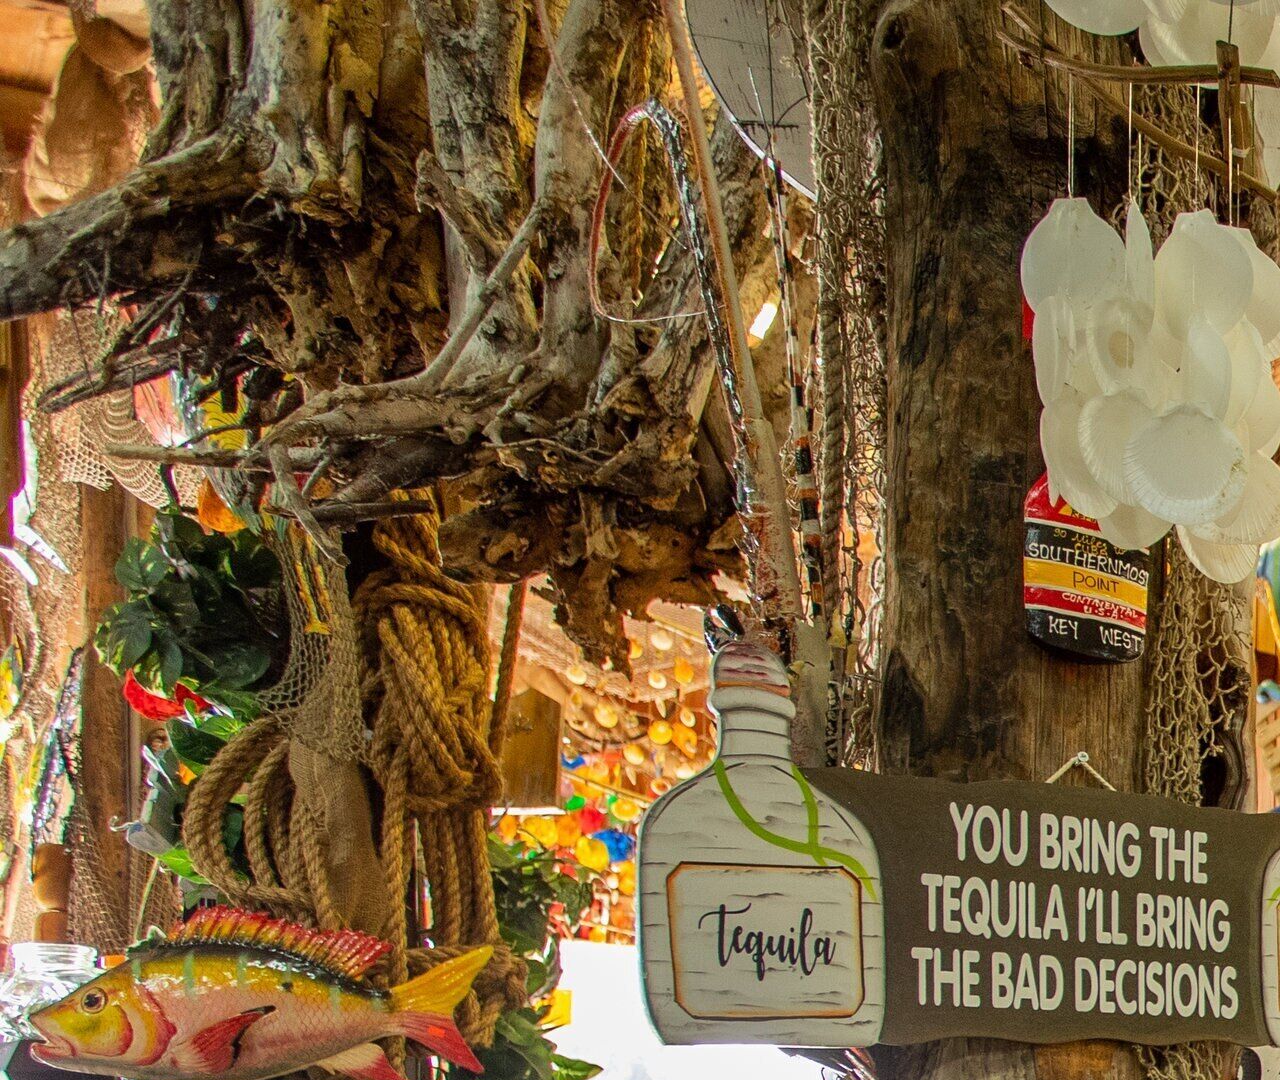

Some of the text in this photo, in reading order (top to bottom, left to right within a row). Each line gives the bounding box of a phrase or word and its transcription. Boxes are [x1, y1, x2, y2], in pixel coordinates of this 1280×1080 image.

[1073, 571, 1119, 593] POINT
[1048, 615, 1143, 652] KEY WEST
[949, 801, 1208, 885] YOU BRING THE
[698, 902, 836, 981] Tequila
[920, 872, 1231, 953] TEQUILA I'LL BRING
[910, 946, 1239, 1020] THE BAD DECISIONS
